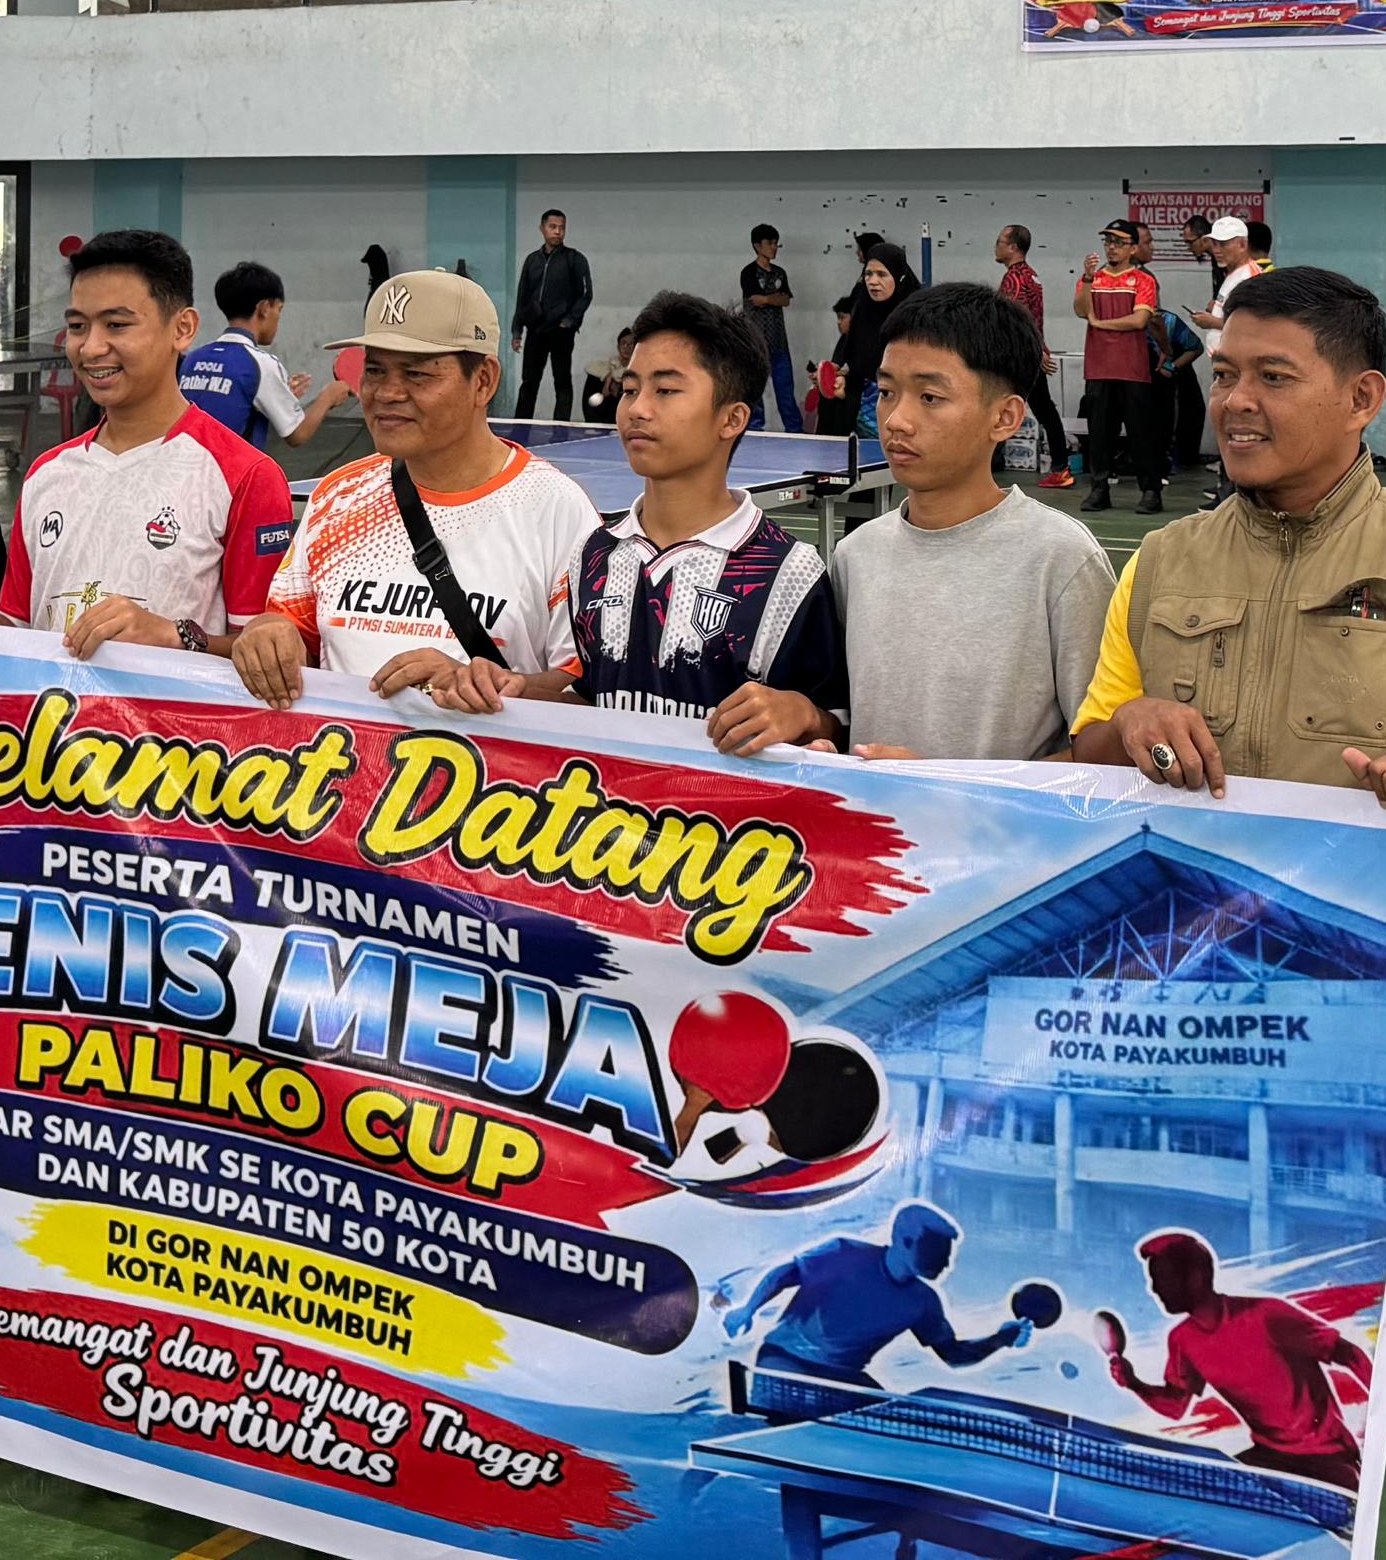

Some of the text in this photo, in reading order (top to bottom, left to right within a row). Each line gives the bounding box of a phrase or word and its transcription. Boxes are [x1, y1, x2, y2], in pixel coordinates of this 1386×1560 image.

[1153, 6, 1341, 28] Semangat dan Junjung Tinggi Sportivitas
[1130, 195, 1262, 206] KAWASAN DILARANG
[337, 579, 508, 630] KEJUROV
[348, 617, 382, 632] PTMSI
[385, 619, 442, 638] SUMATERA
[362, 734, 811, 958] Datang
[42, 843, 520, 963] PESERTA TURNAMEN
[267, 937, 663, 1141] MEJA
[1034, 1008, 1312, 1041] GOR NAN OMPEK
[1048, 1040, 1287, 1068] KOTA PAYAKUMBUH
[18, 1022, 540, 1192] PALIKO CUP
[37, 1156, 499, 1291] DAN KABUPATEN 50 KOTA
[42, 1114, 210, 1175] SMA/SMK
[219, 1152, 261, 1185] SE
[270, 1160, 365, 1213] KOTA
[374, 1189, 646, 1293] PAYAKUMBUH
[106, 1252, 413, 1356] KOTA PAYAKUMBUH
[108, 1219, 416, 1321] DI GOR NAN OMPEK
[101, 1362, 396, 1484] Sportivitas
[159, 1325, 238, 1379] dan
[243, 1345, 409, 1445] Junjung
[420, 1400, 561, 1487] Tinggi
